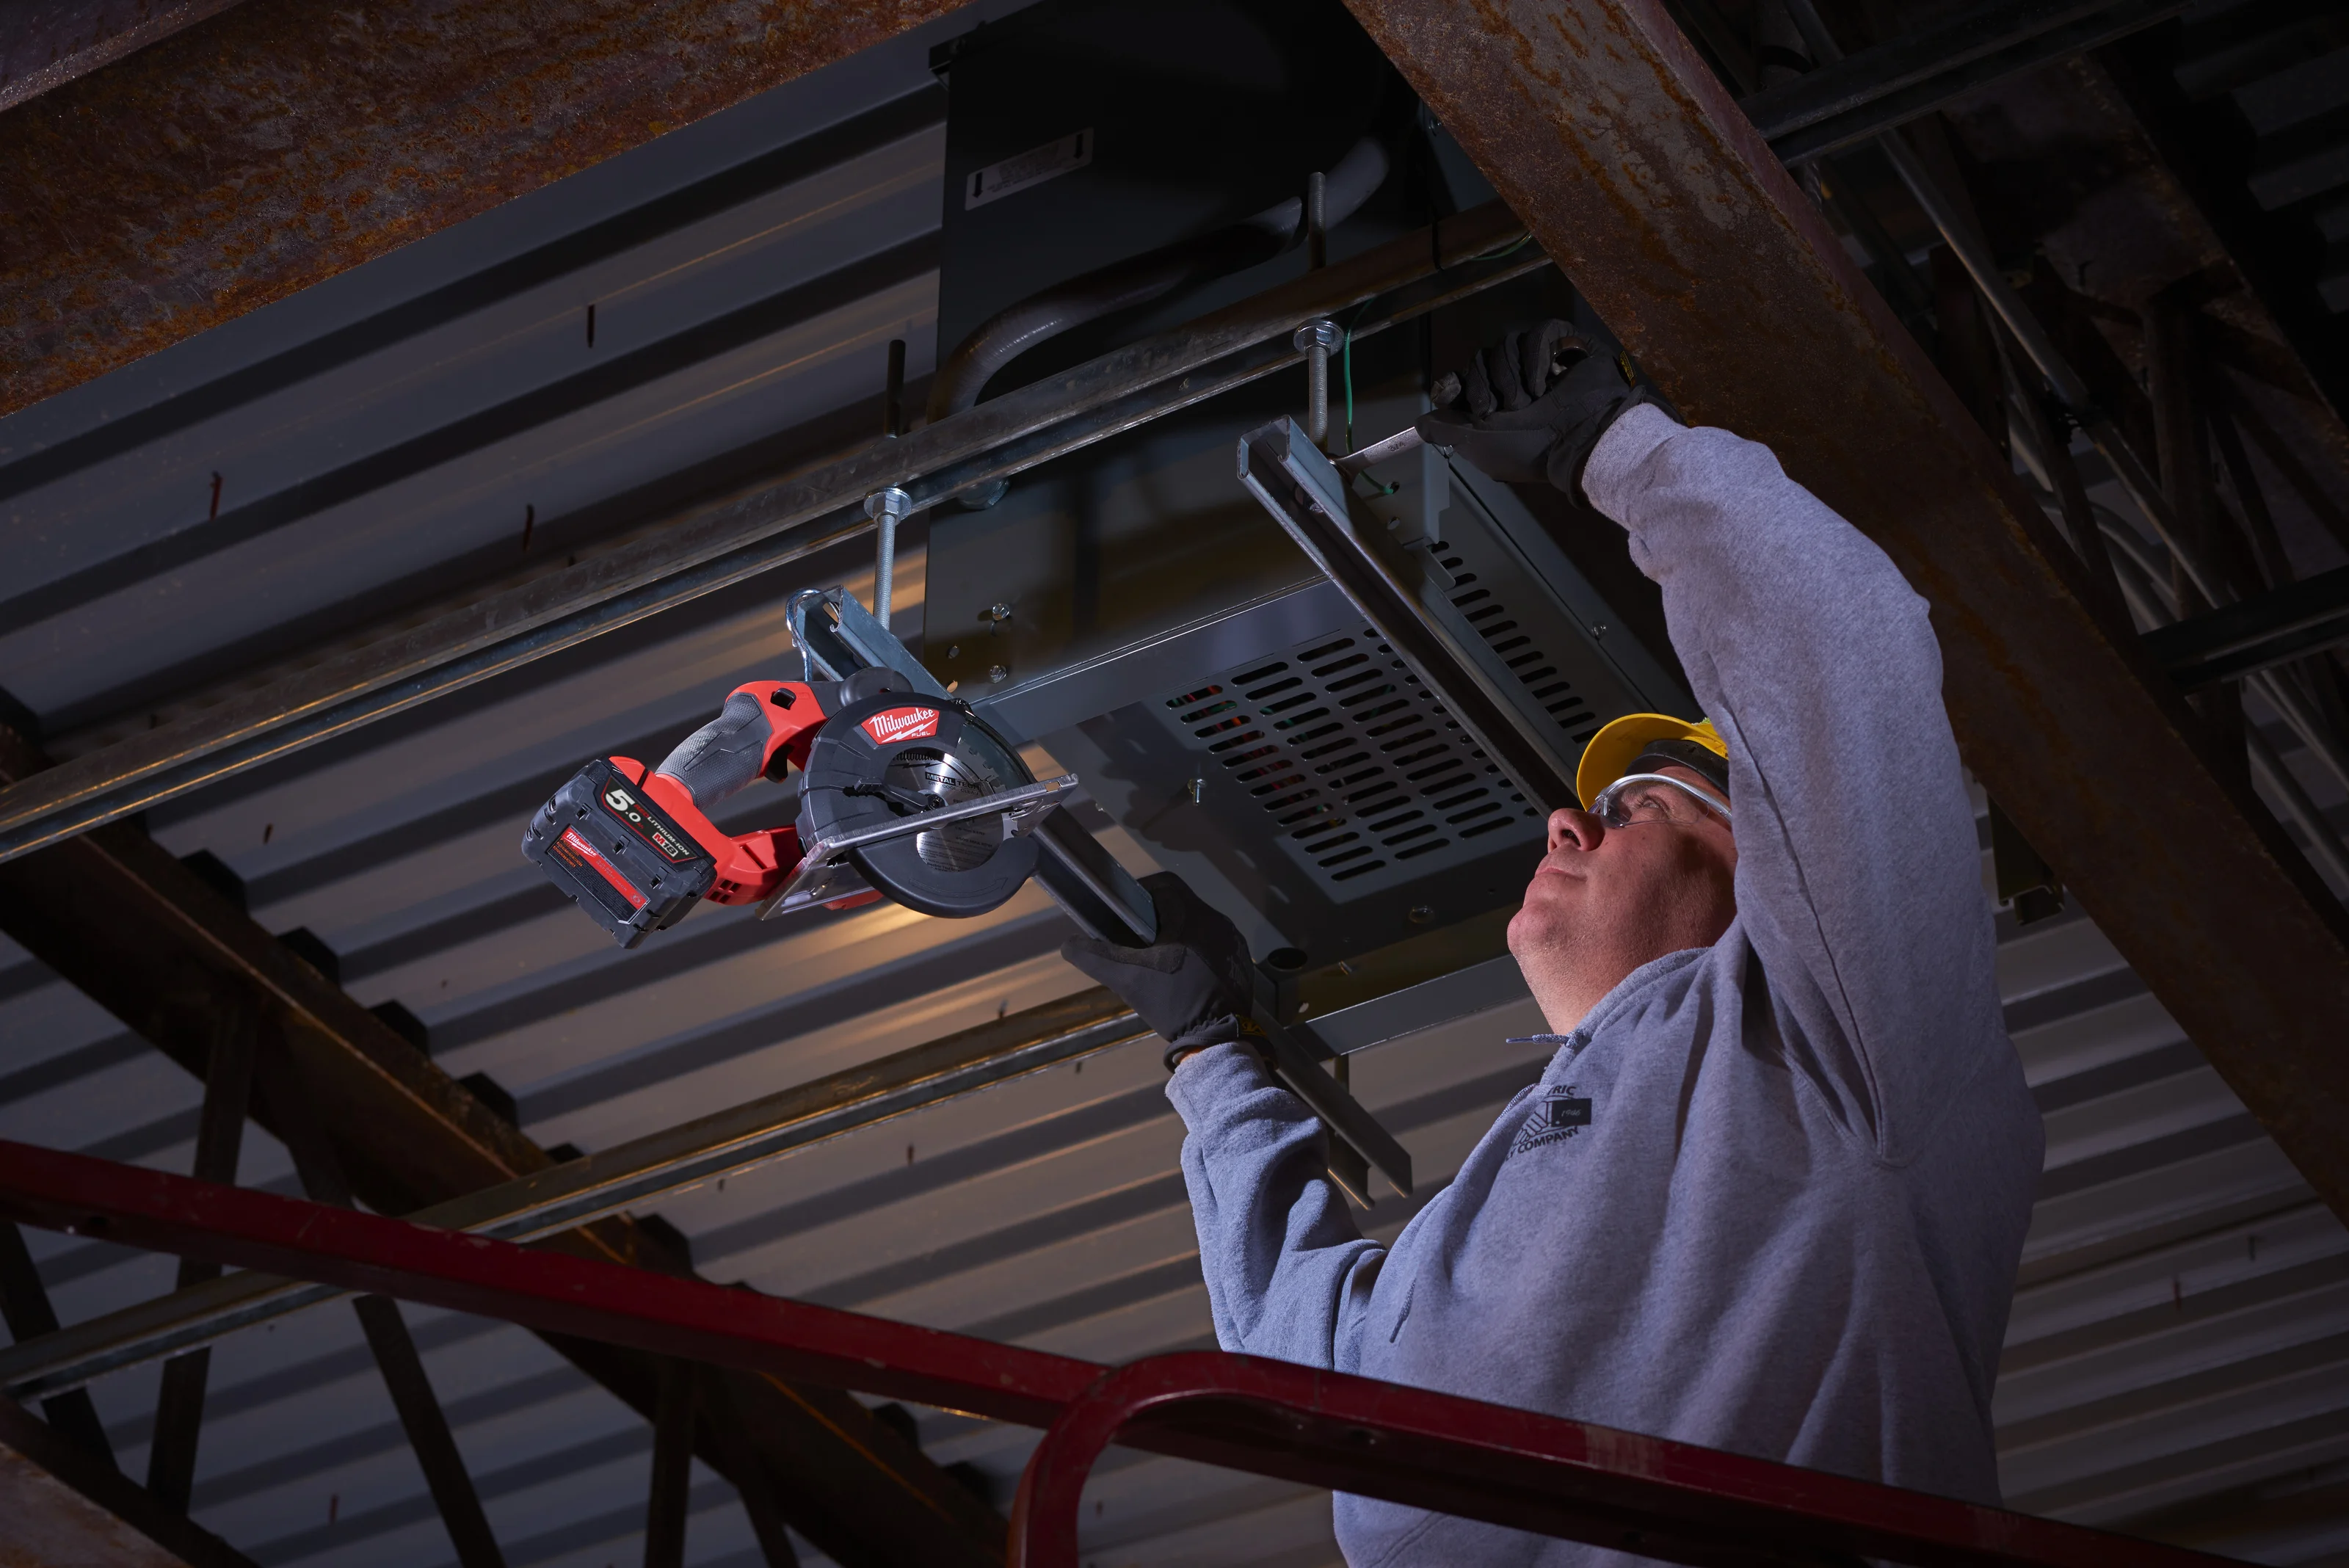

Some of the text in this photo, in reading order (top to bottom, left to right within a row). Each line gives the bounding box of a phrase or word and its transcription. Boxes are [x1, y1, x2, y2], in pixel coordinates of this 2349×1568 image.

[869, 708, 935, 737] Milwaukee
[926, 772, 981, 791] METAL TECH
[606, 789, 641, 822] 5.0
[566, 832, 598, 857] Milwaukee
[653, 833, 675, 854] M18
[1517, 1126, 1579, 1154] COMPANY
